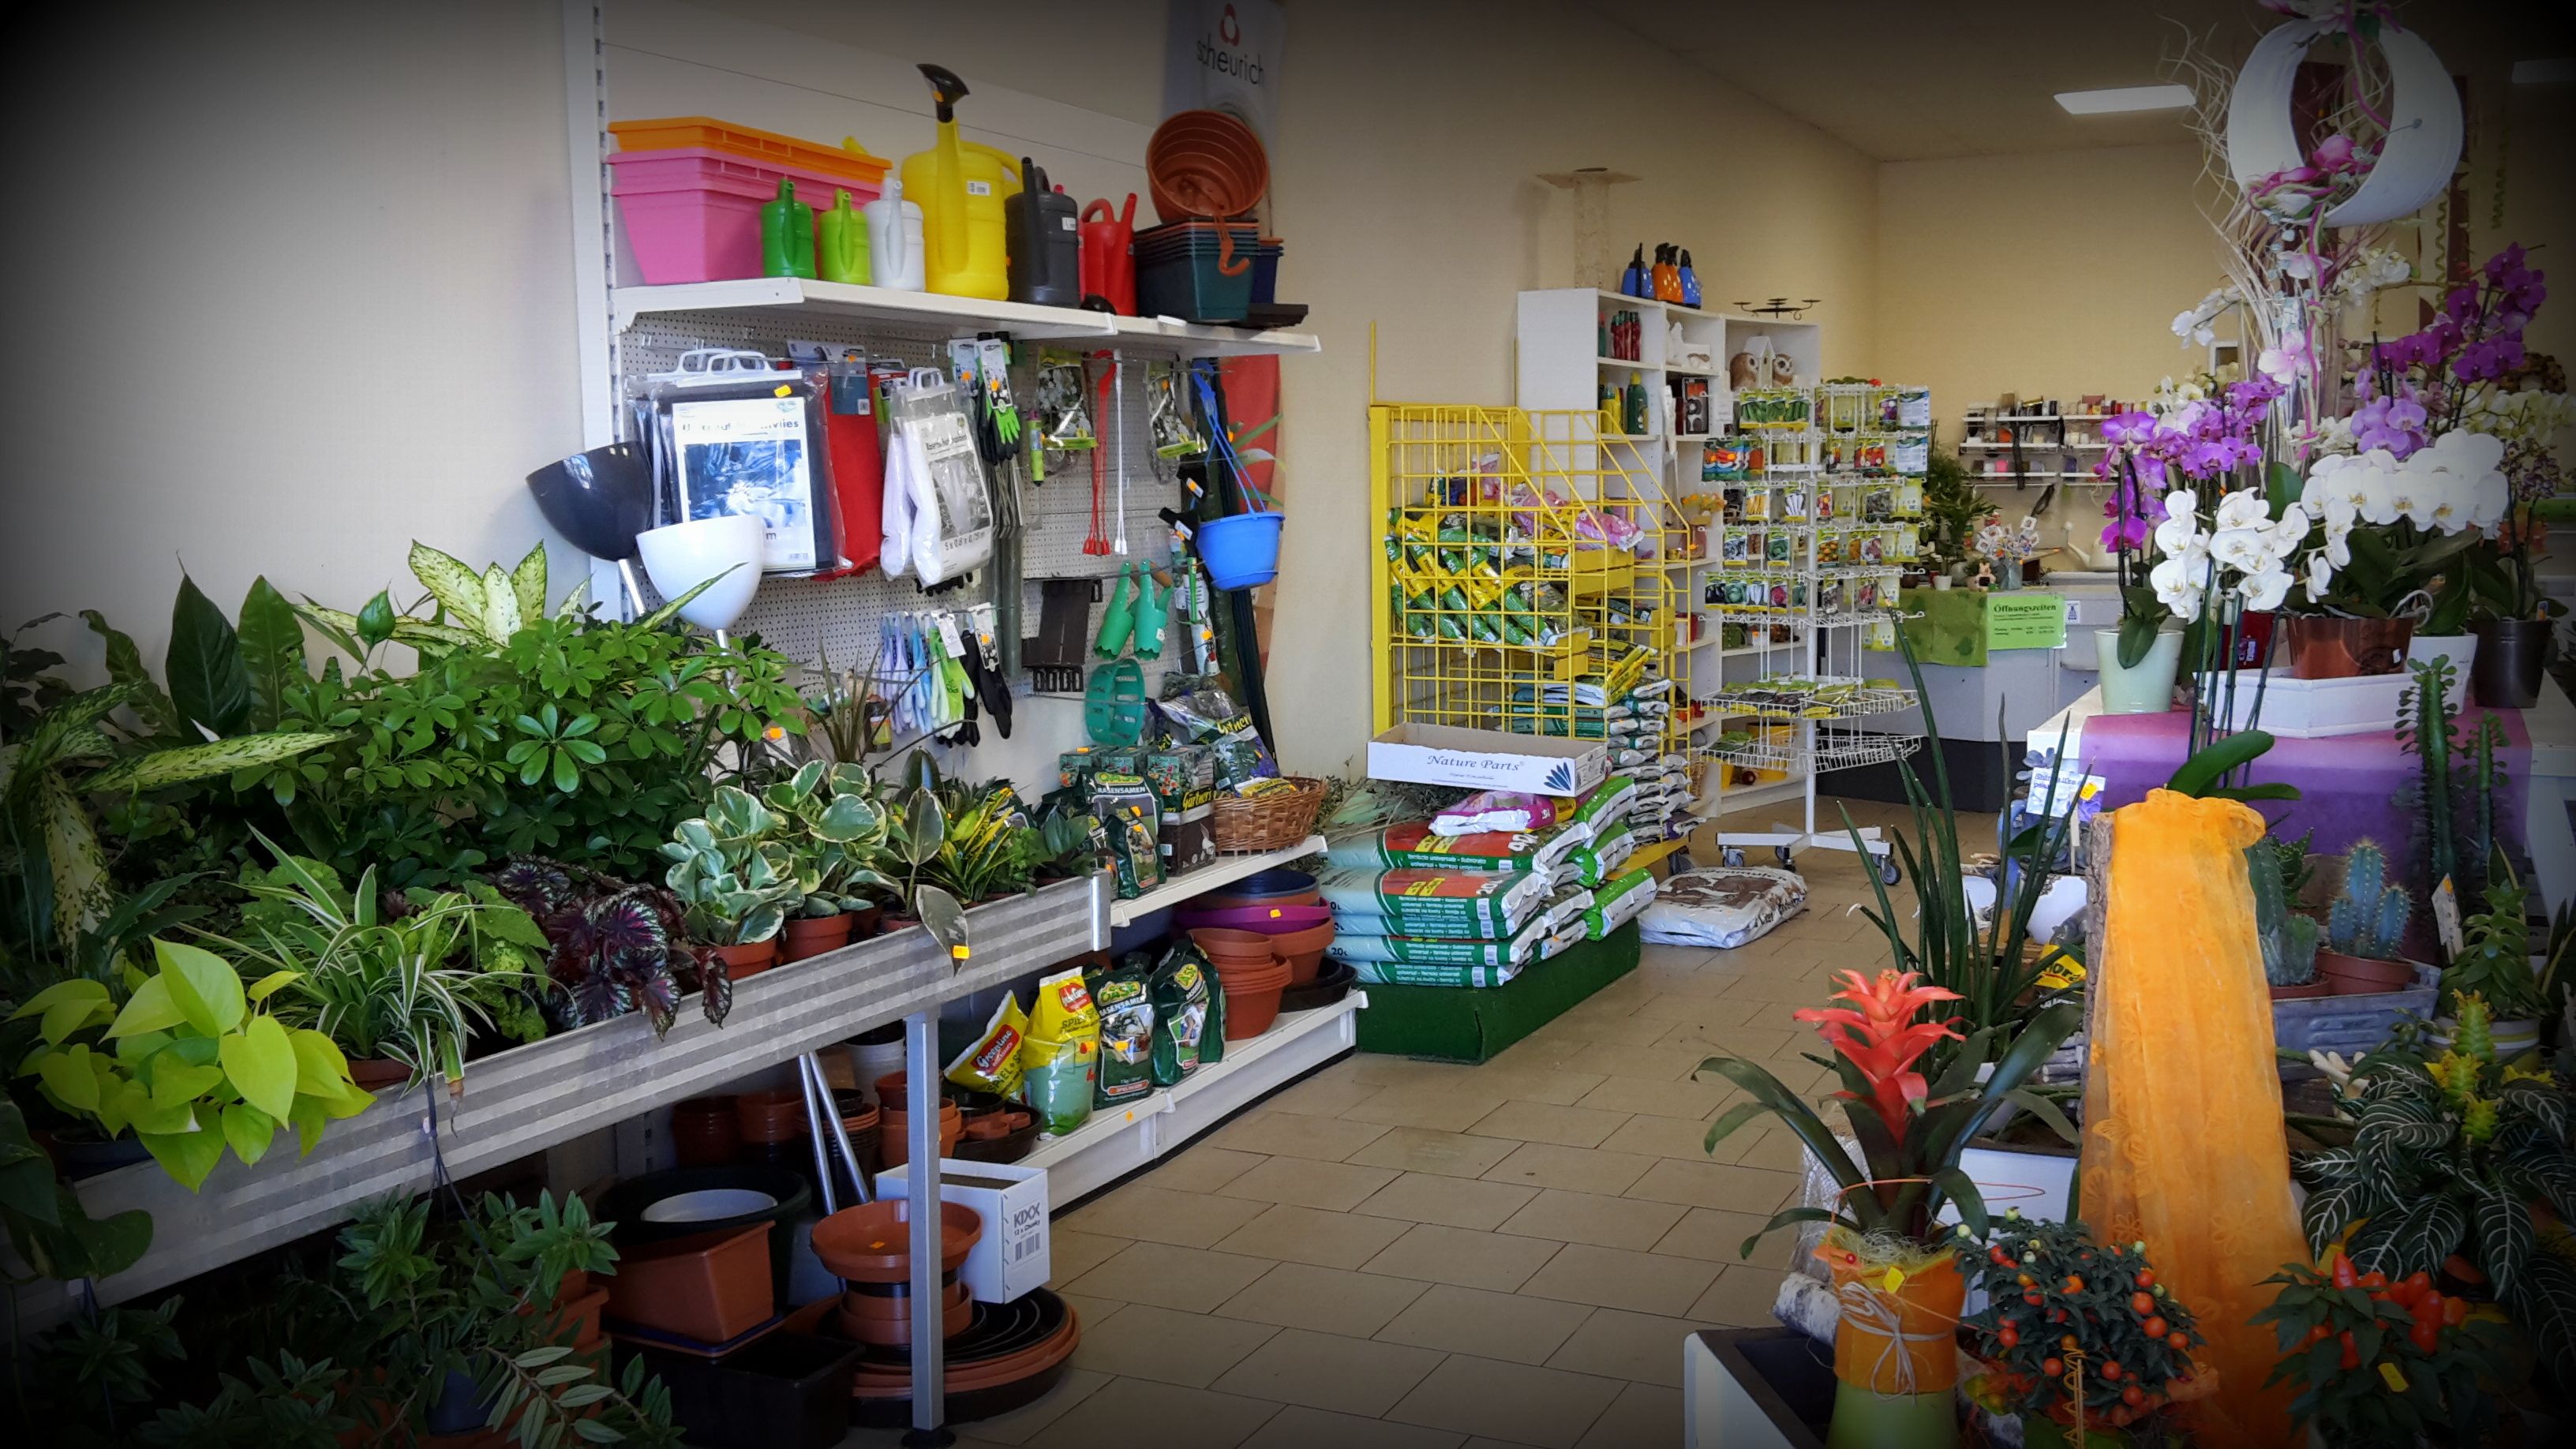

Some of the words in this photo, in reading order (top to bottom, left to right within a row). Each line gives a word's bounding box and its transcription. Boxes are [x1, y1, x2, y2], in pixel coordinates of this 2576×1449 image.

[1196, 33, 1264, 88] scheurich
[1427, 755, 1477, 769] Nature
[1014, 1202, 1040, 1227] KIXX
